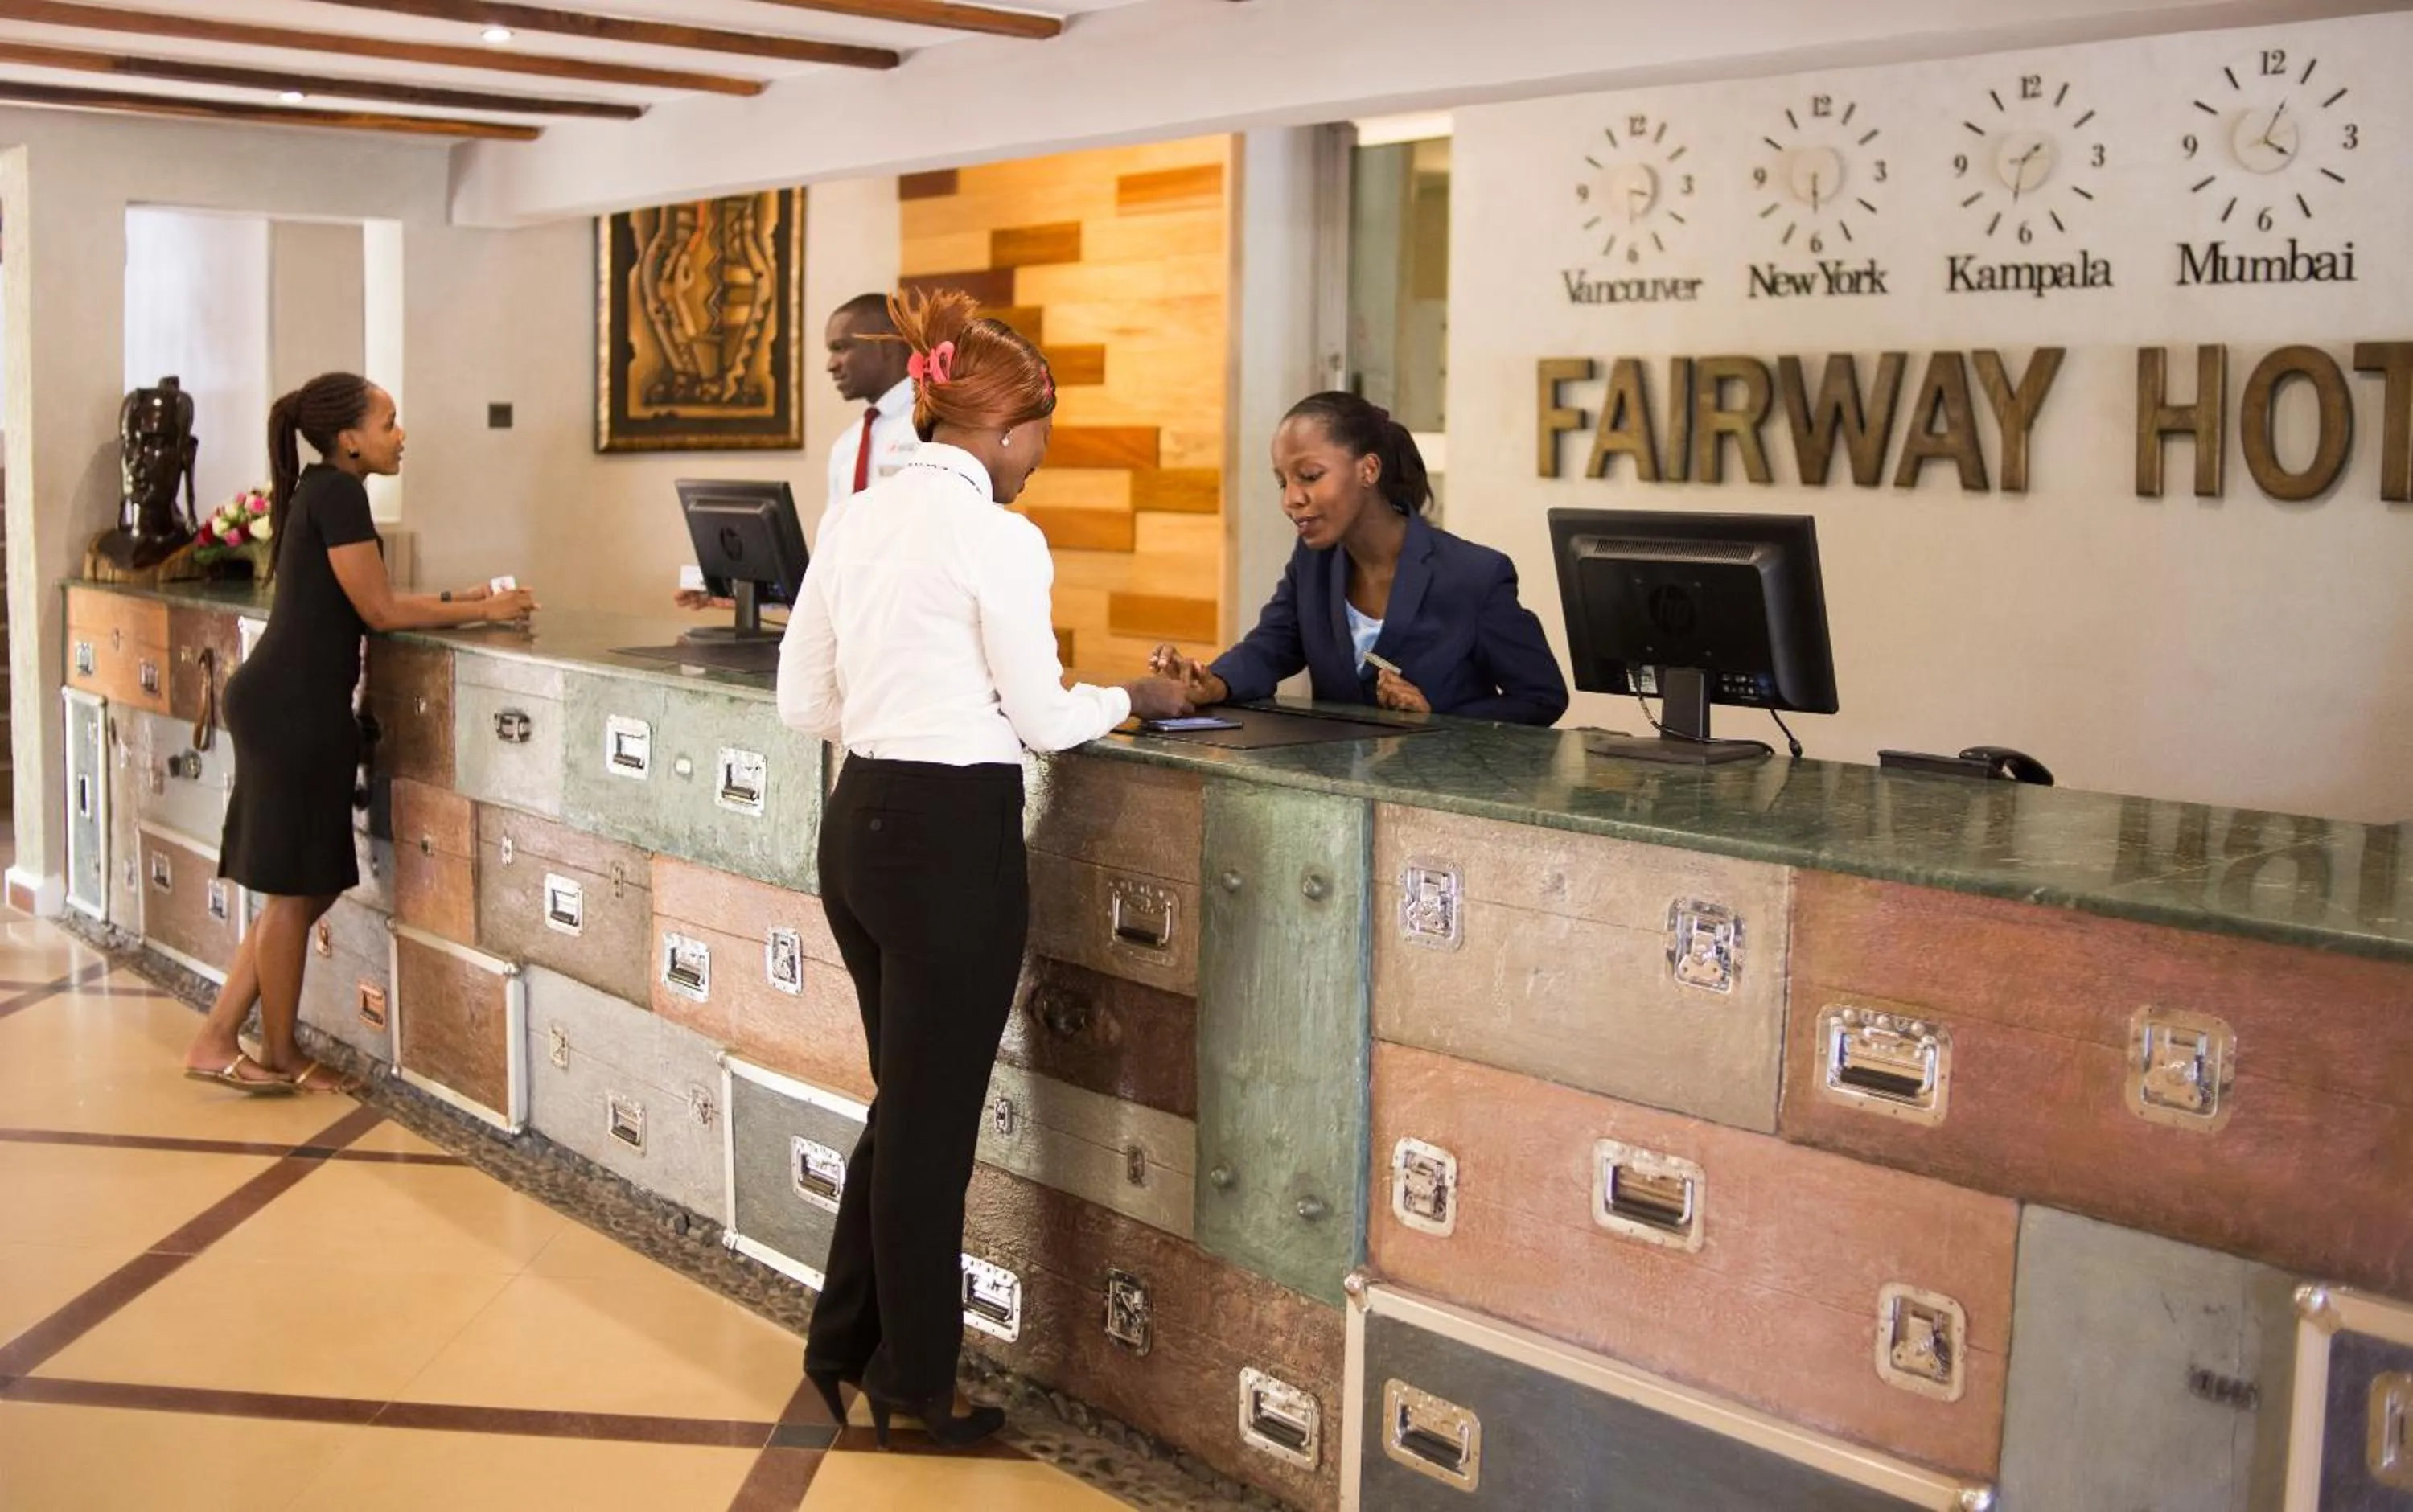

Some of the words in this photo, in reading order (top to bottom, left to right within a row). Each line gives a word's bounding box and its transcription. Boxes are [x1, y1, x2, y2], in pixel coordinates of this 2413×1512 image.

[2259, 50, 2287, 76] 12
[2020, 75, 2042, 100] 12
[1813, 95, 1832, 117] 12
[2183, 134, 2198, 158] 9
[2342, 124, 2358, 150] 3
[1954, 154, 1967, 177] 9
[2091, 143, 2104, 167] 3
[1875, 161, 1887, 182] 3
[2257, 207, 2273, 232] 6
[1810, 232, 1822, 253] 6
[2018, 222, 2032, 244] 6
[1946, 249, 2113, 297] Kampala
[2175, 238, 2357, 286] Mumbai
[1562, 268, 1703, 304] Vancouver
[1537, 347, 2066, 493] FAIRWAY
